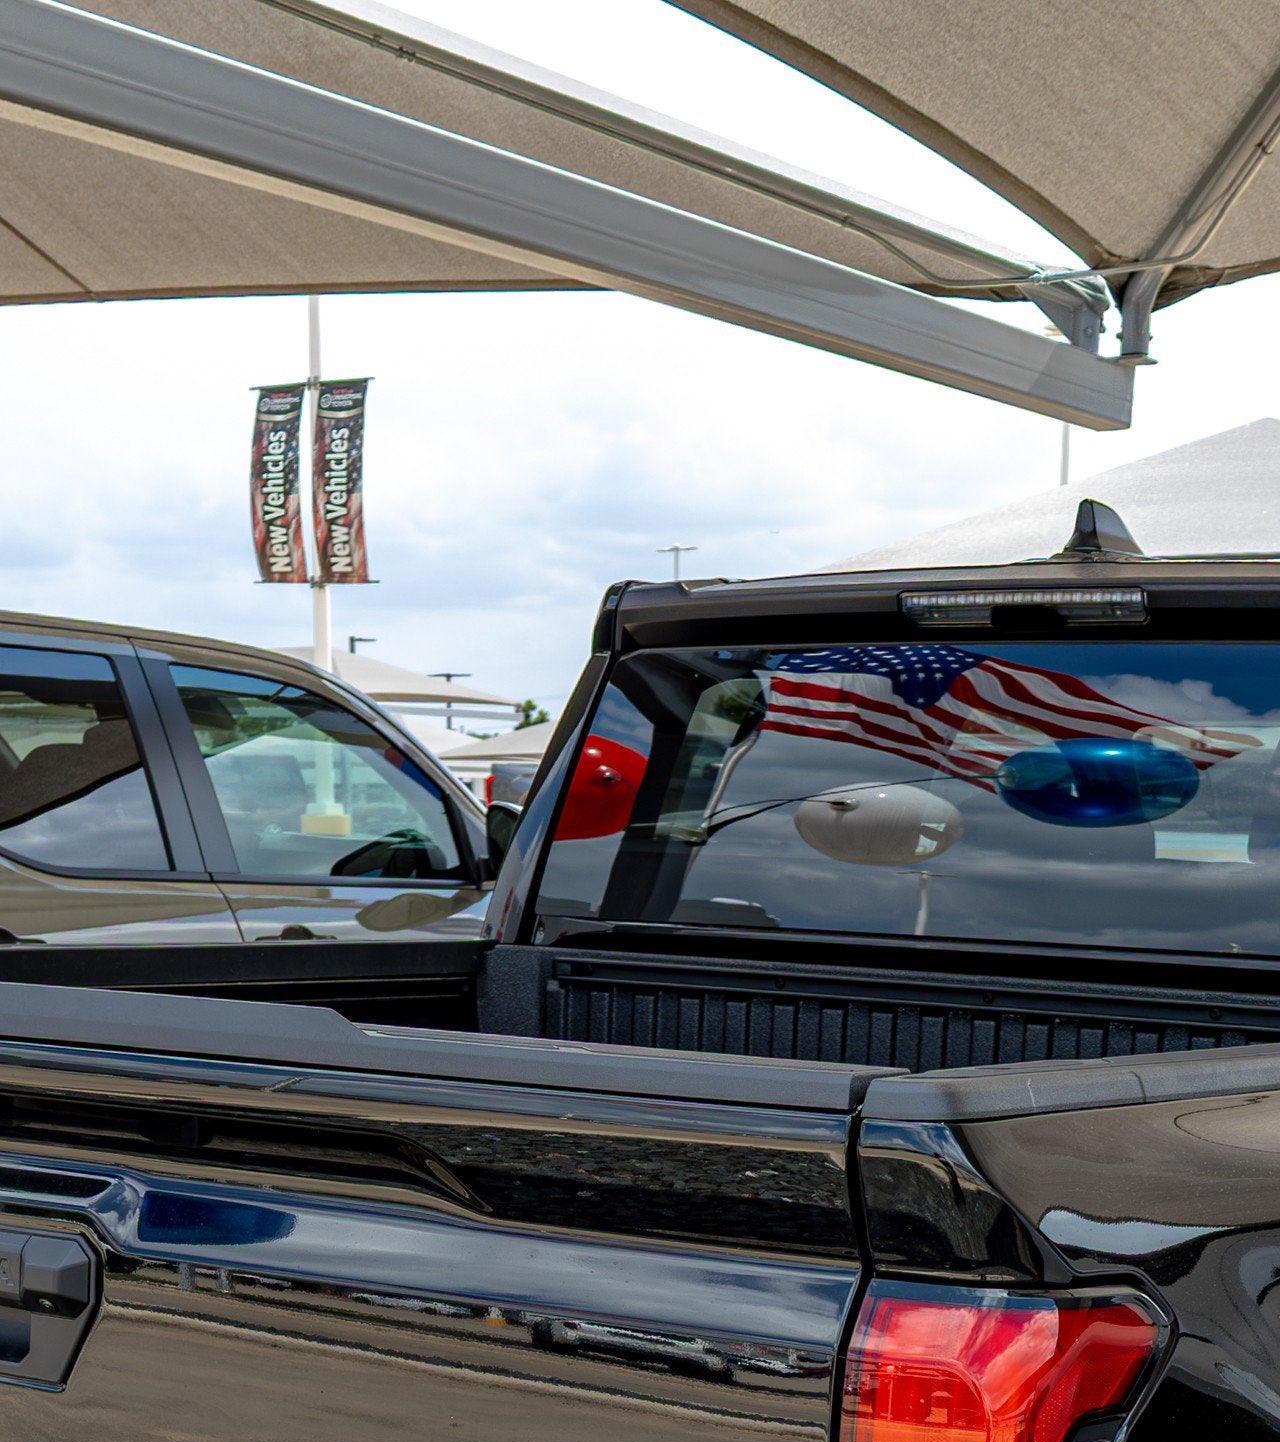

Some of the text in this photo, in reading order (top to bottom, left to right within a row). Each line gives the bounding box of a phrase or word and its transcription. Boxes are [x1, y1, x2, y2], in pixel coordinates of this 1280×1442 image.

[262, 429, 288, 521] Vehicles
[324, 426, 350, 520] Vehicles
[270, 523, 293, 573] New
[330, 523, 354, 572] New
